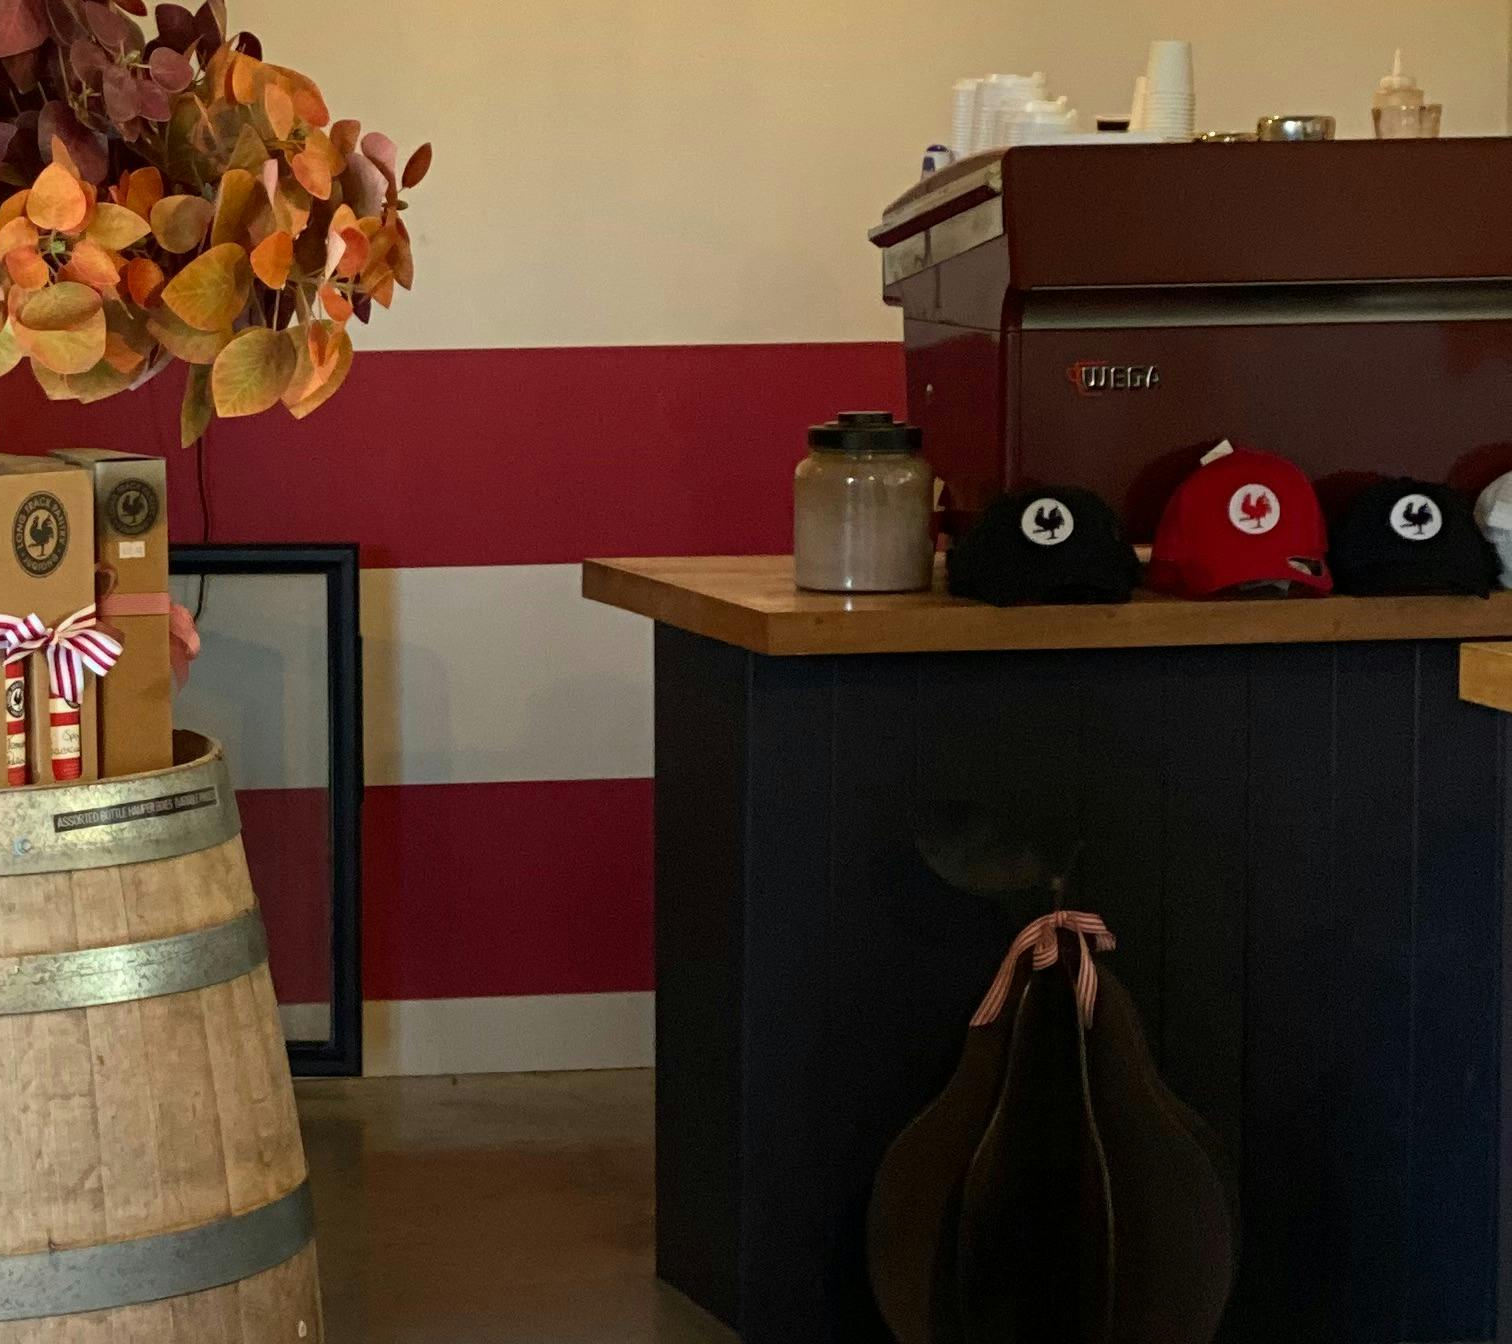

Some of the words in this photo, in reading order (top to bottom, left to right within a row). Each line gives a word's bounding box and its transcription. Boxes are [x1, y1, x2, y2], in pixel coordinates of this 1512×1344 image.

[1081, 365, 1160, 389] WEGA
[16, 514, 26, 547] LONG
[57, 811, 100, 829] ASSORTED
